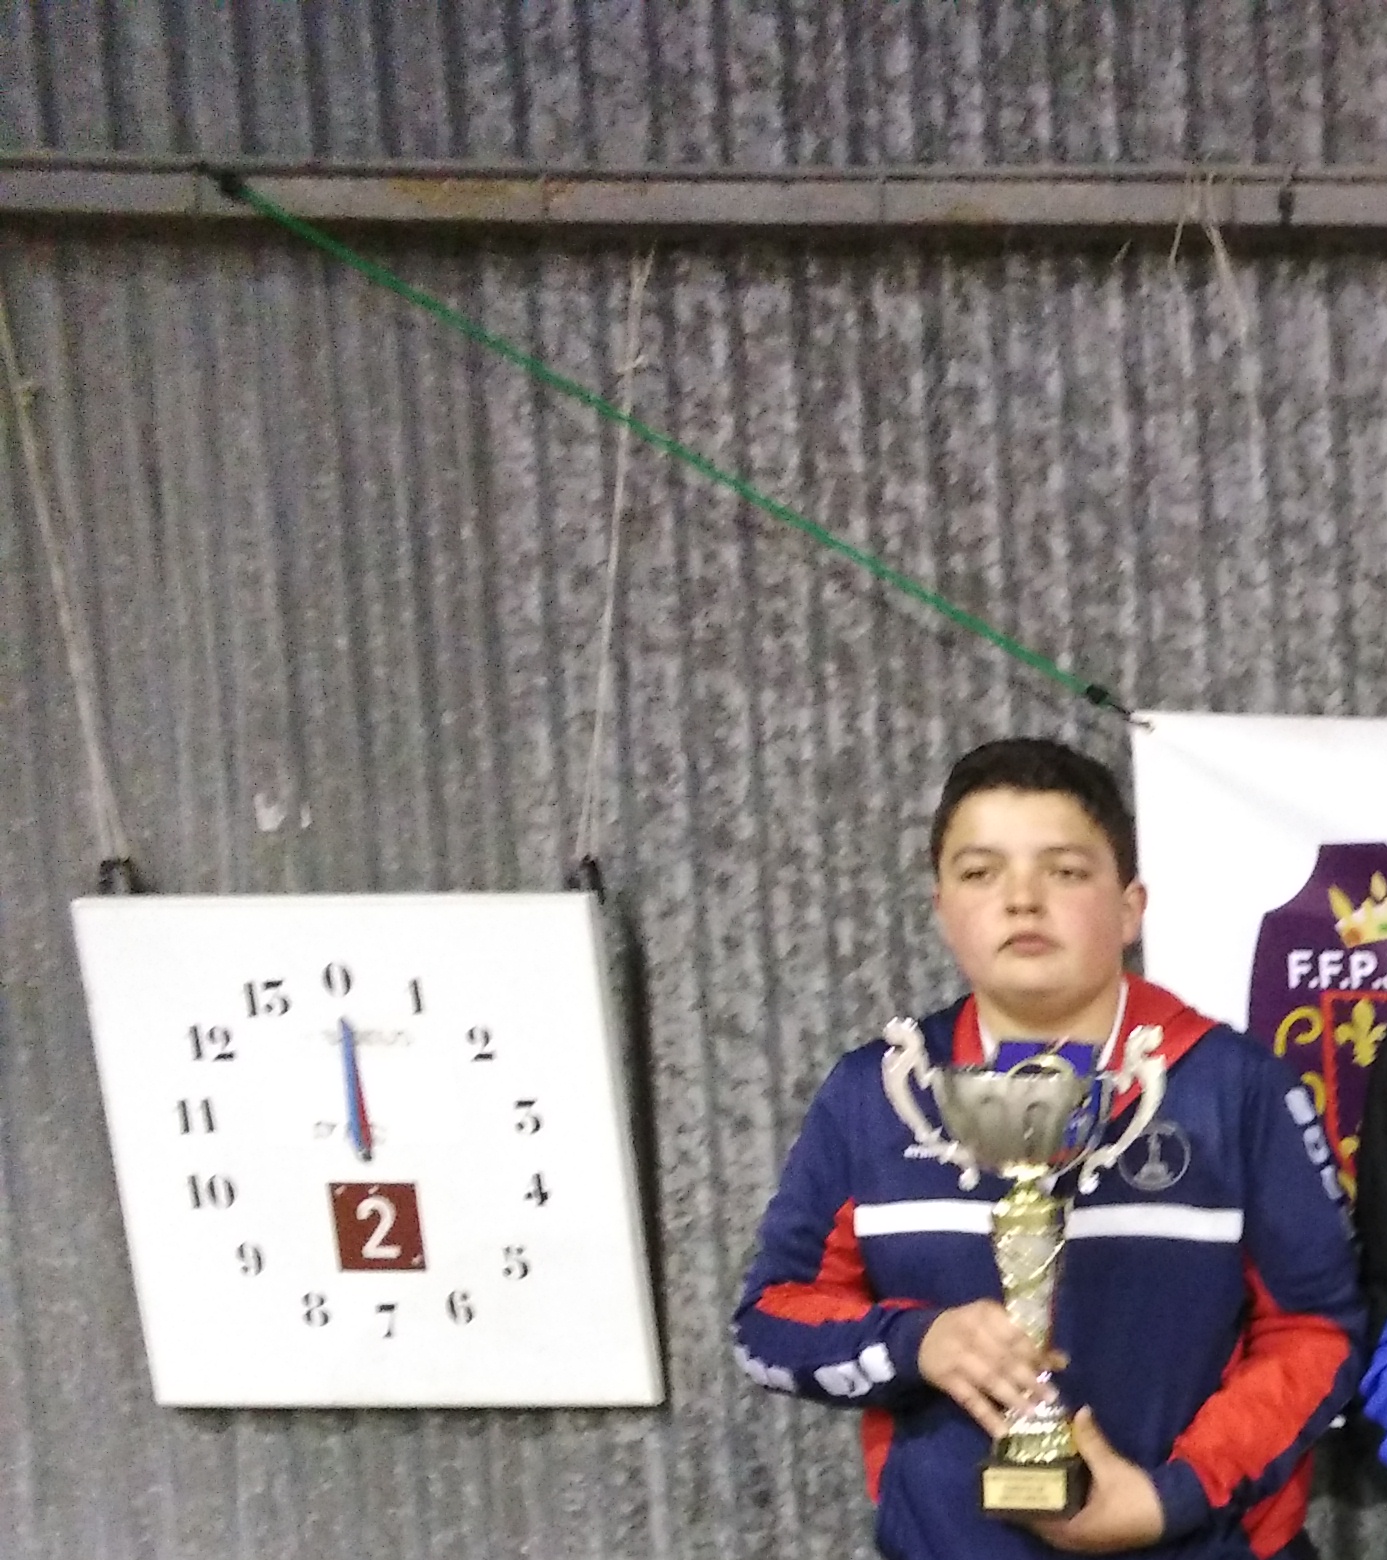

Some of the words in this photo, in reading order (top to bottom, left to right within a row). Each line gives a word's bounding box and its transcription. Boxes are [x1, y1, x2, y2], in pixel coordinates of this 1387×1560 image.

[321, 962, 353, 998] 0
[407, 978, 424, 1015] 1
[187, 1025, 237, 1063] 12
[466, 1025, 496, 1063] 2
[175, 1097, 216, 1136] 11
[514, 1098, 543, 1135] 3
[186, 1174, 237, 1210] 10
[524, 1172, 550, 1208] 4
[356, 1195, 402, 1259] 2
[236, 1242, 265, 1277] 9
[502, 1244, 530, 1281] 5
[302, 1291, 332, 1328] 8
[375, 1302, 397, 1339] 7
[446, 1290, 475, 1326] 6
